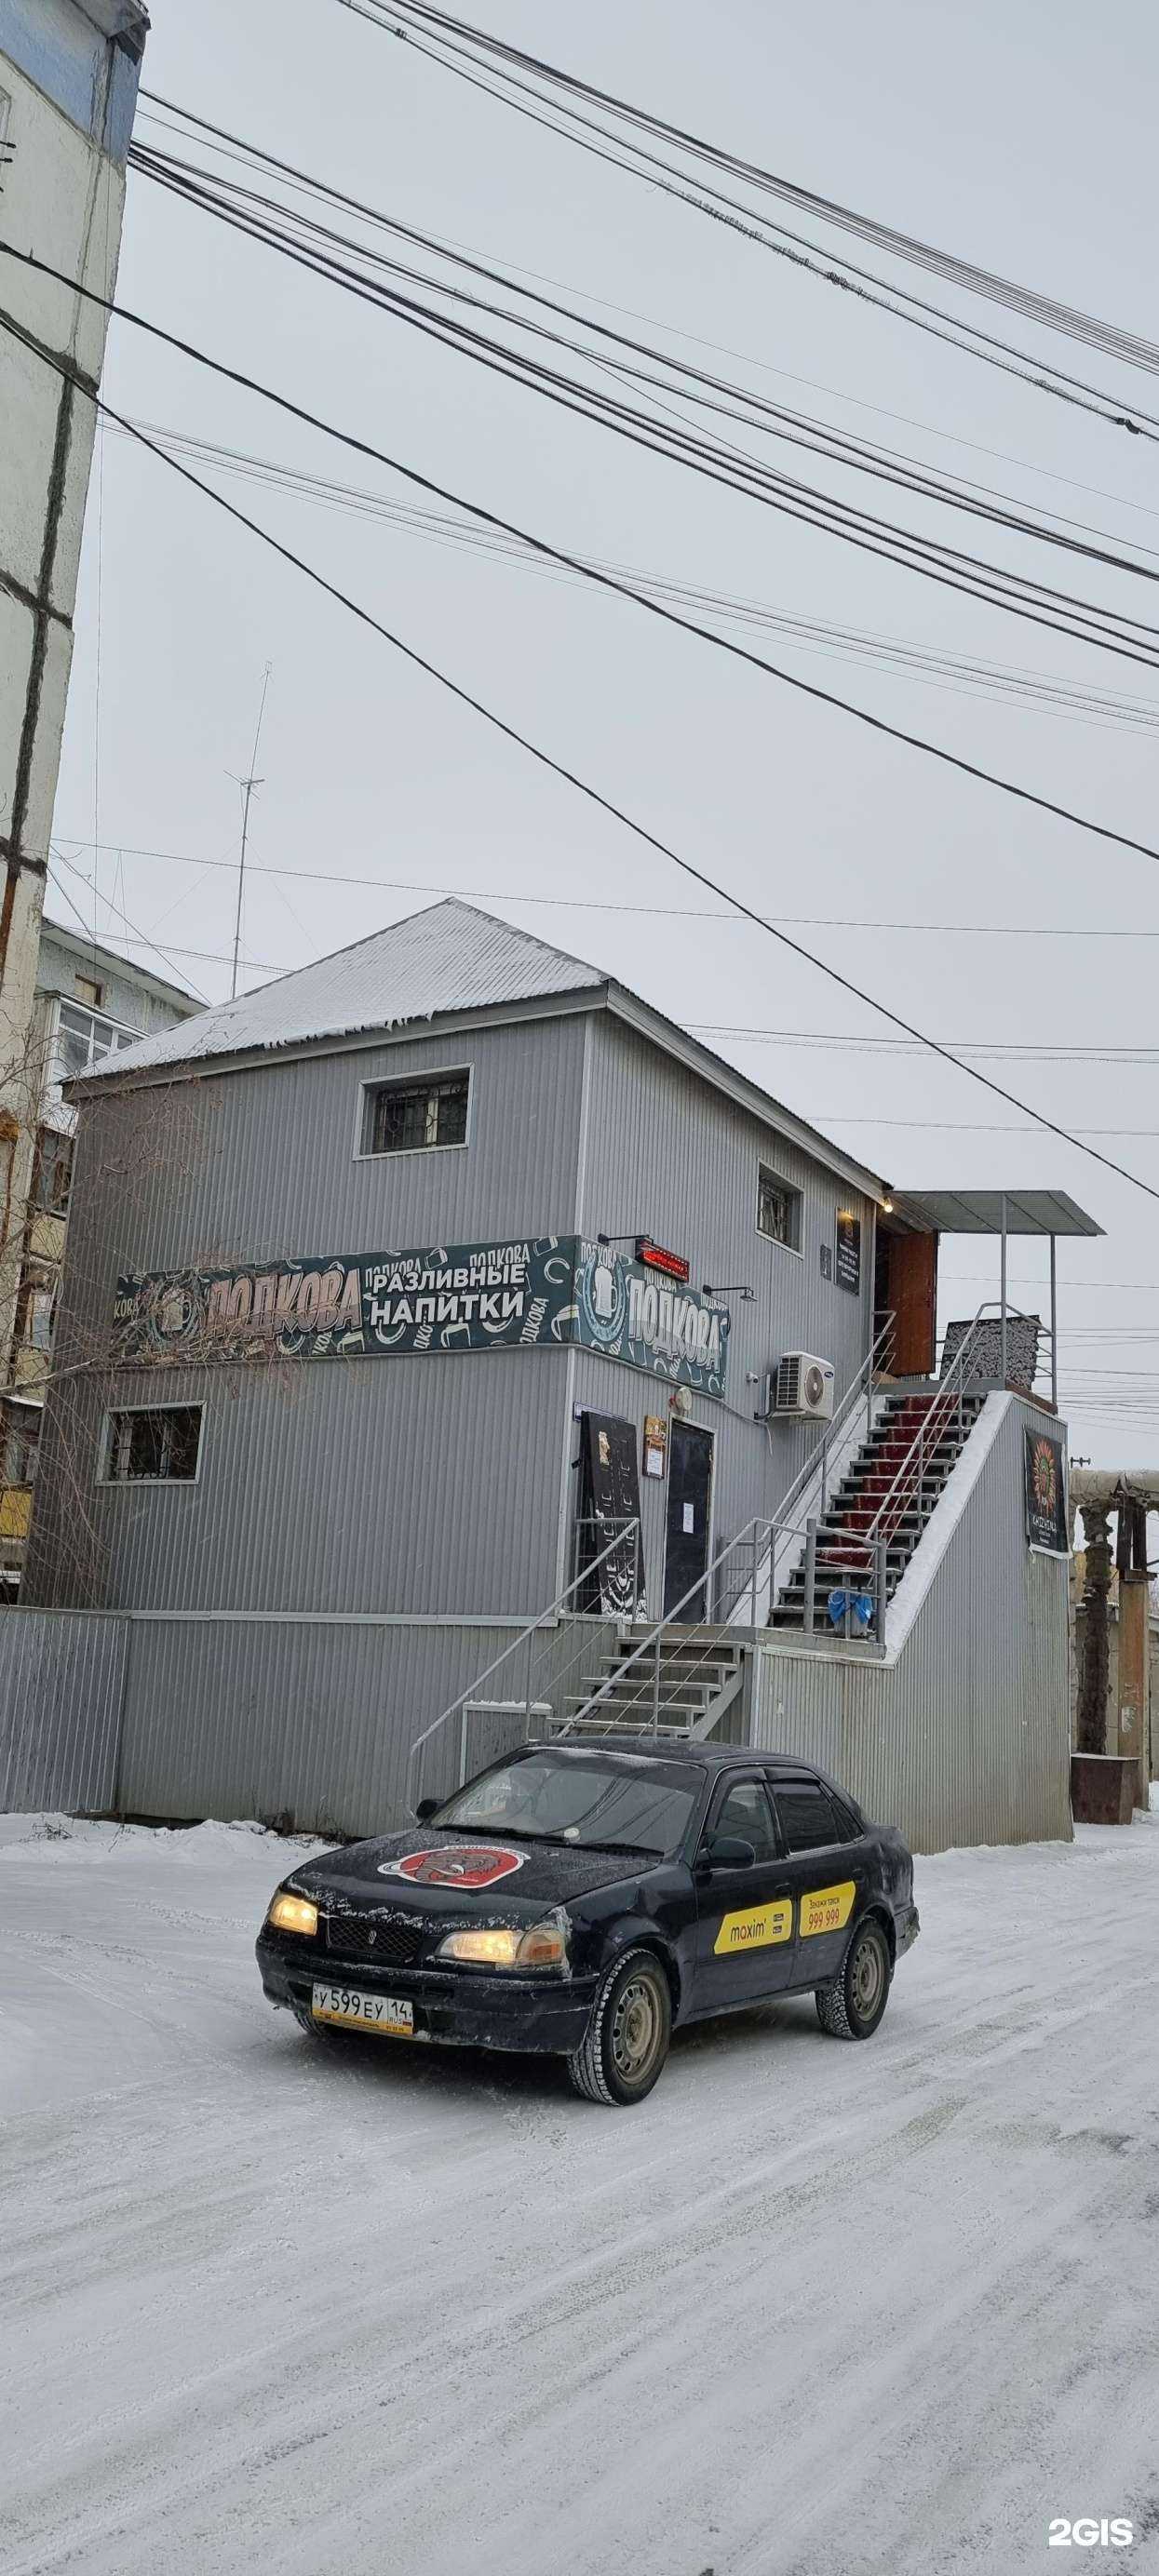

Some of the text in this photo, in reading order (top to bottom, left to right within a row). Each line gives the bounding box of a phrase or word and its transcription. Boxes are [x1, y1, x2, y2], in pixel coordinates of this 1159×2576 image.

[372, 1264, 527, 1294] РАЗЛИВНЫЕ
[205, 1268, 362, 1341] ПОДКОВА
[371, 1291, 524, 1326] НАПИТКИ
[628, 1279, 721, 1374] ПОДКОВА
[808, 1908, 840, 1931] 999 999
[391, 2001, 408, 2019] 14
